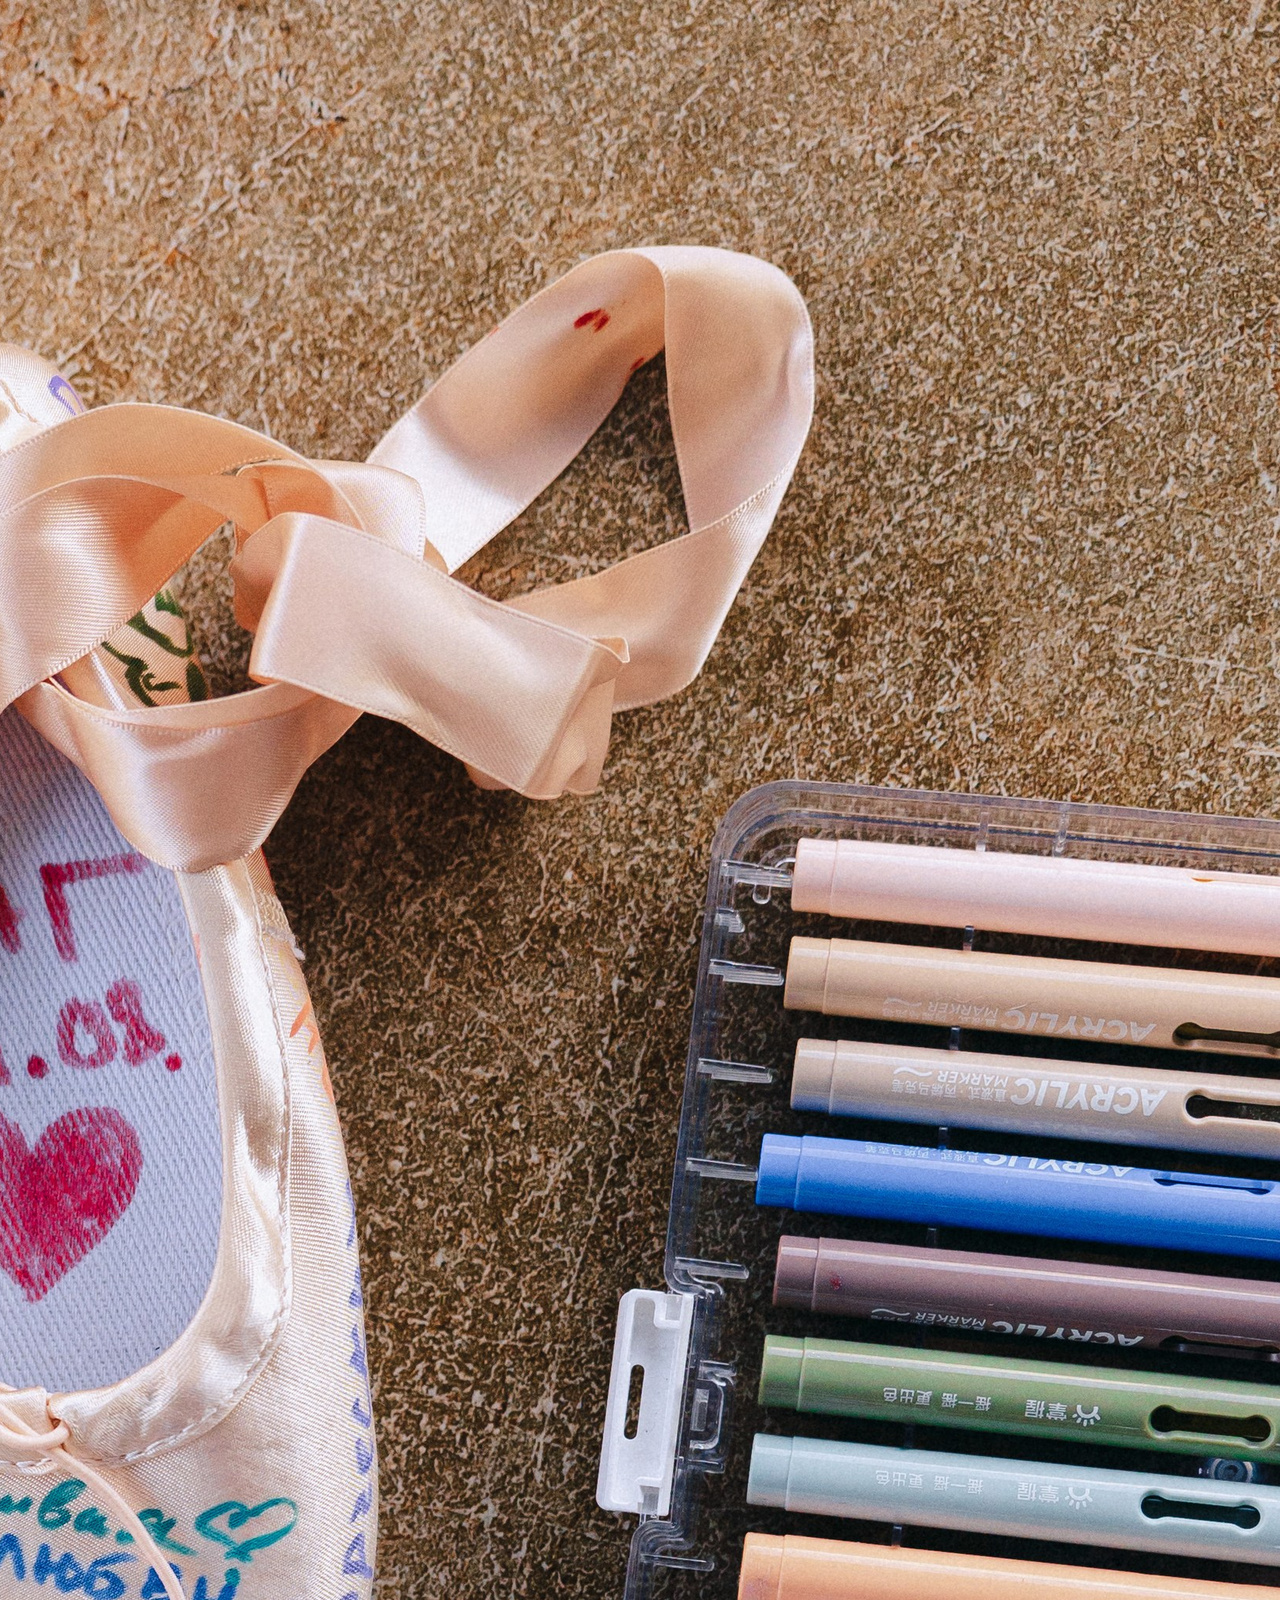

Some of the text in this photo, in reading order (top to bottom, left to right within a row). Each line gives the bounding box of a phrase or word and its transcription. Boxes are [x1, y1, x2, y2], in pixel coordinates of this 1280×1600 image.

[1006, 1008, 1156, 1042] ACRYLIC
[938, 1069, 1009, 1088] MARKER
[1012, 1078, 1167, 1116] ACRYLIC
[916, 1311, 987, 1328] MARKER
[883, 1387, 1068, 1421] 掌握 摇一摇 更出色
[875, 1469, 1061, 1504] 掌握 摇一摇 更出色
